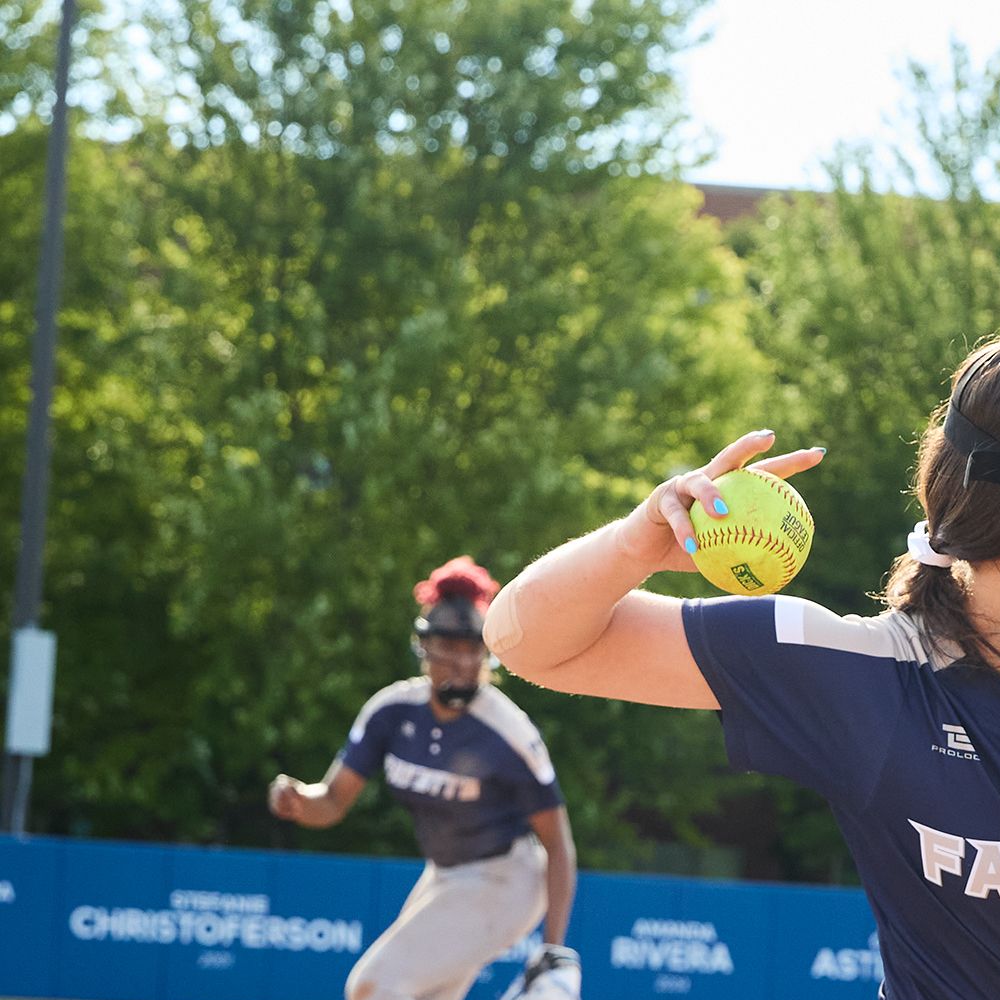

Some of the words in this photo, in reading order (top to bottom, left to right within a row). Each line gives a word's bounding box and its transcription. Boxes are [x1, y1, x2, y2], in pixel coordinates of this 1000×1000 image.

[780, 520, 805, 552] OFFICIAL
[783, 511, 810, 545] LEAGUE
[69, 905, 363, 953] CHRISTOFERSON
[611, 936, 734, 975] RIVERA
